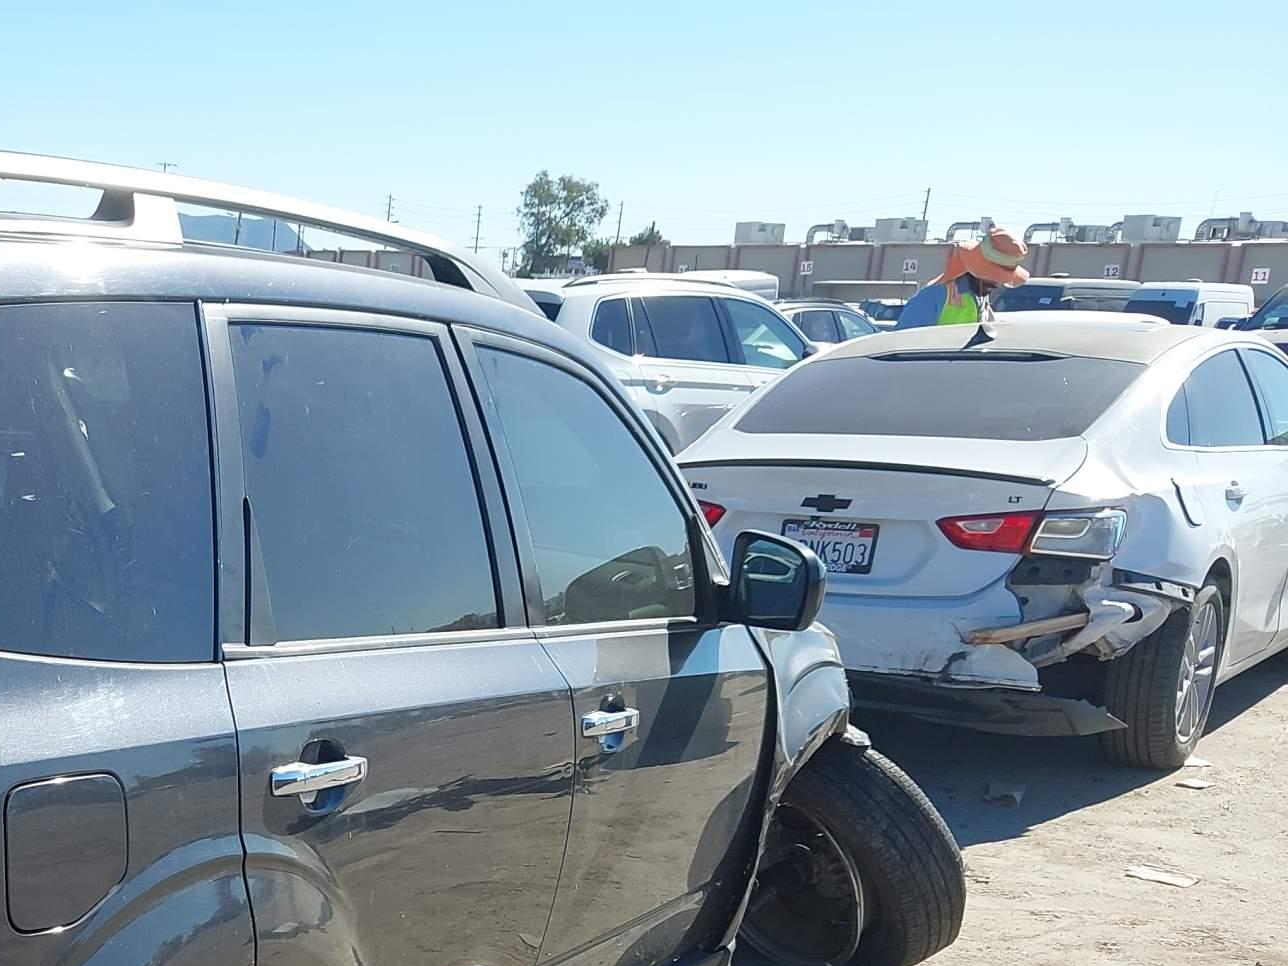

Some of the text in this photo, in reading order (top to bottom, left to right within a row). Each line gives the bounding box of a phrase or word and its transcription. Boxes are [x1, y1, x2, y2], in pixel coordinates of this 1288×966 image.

[904, 261, 916, 271] 14
[1105, 266, 1119, 278] 12
[1253, 270, 1269, 282] 11
[1008, 495, 1024, 504] LT
